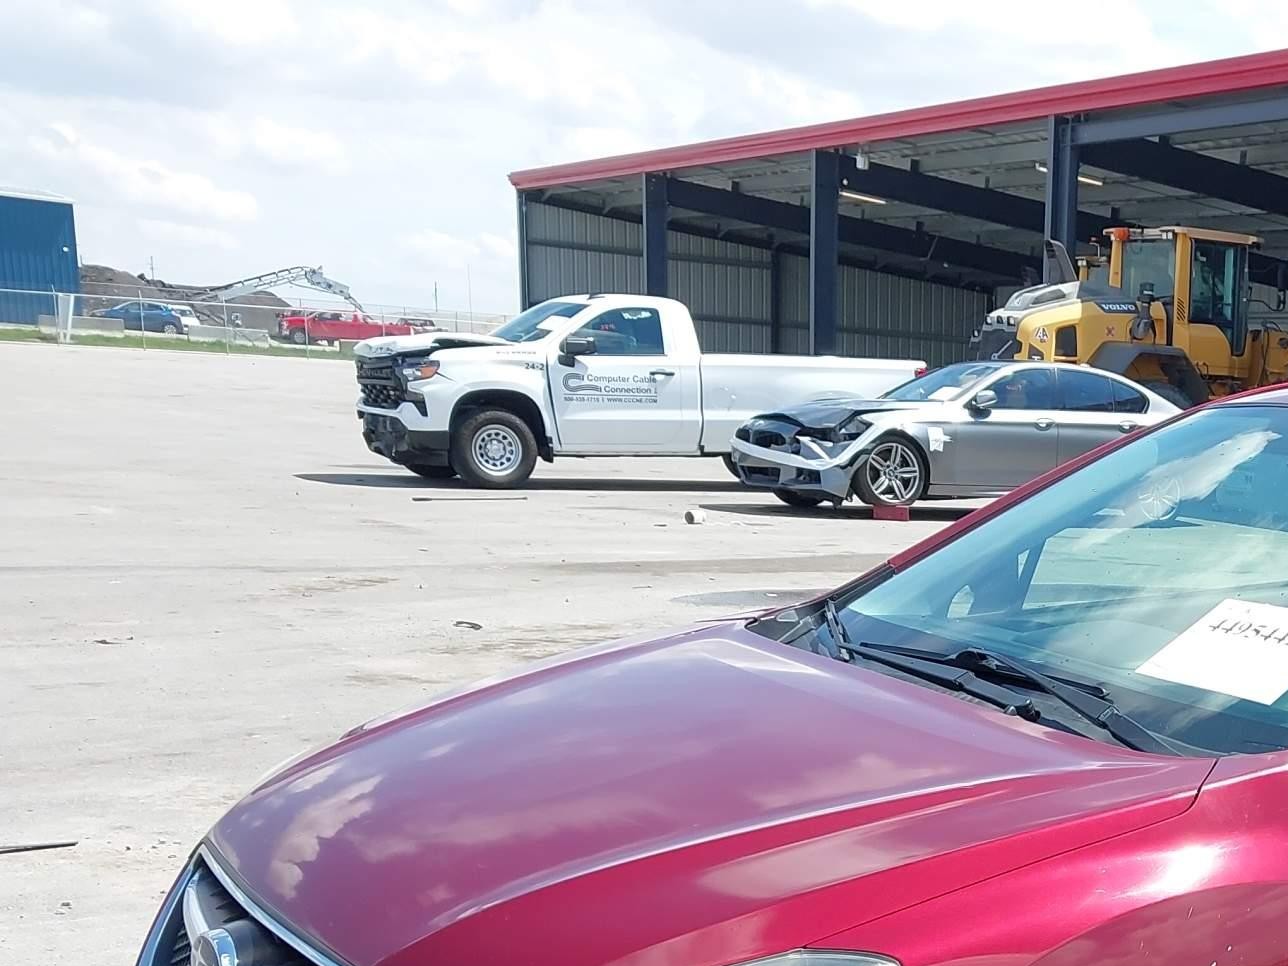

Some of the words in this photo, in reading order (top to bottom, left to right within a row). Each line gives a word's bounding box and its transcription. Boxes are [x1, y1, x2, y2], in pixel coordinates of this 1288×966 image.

[1101, 303, 1136, 311] VOLVO
[586, 374, 630, 384] Computer
[632, 375, 657, 384] Cable
[603, 385, 651, 394] Connection
